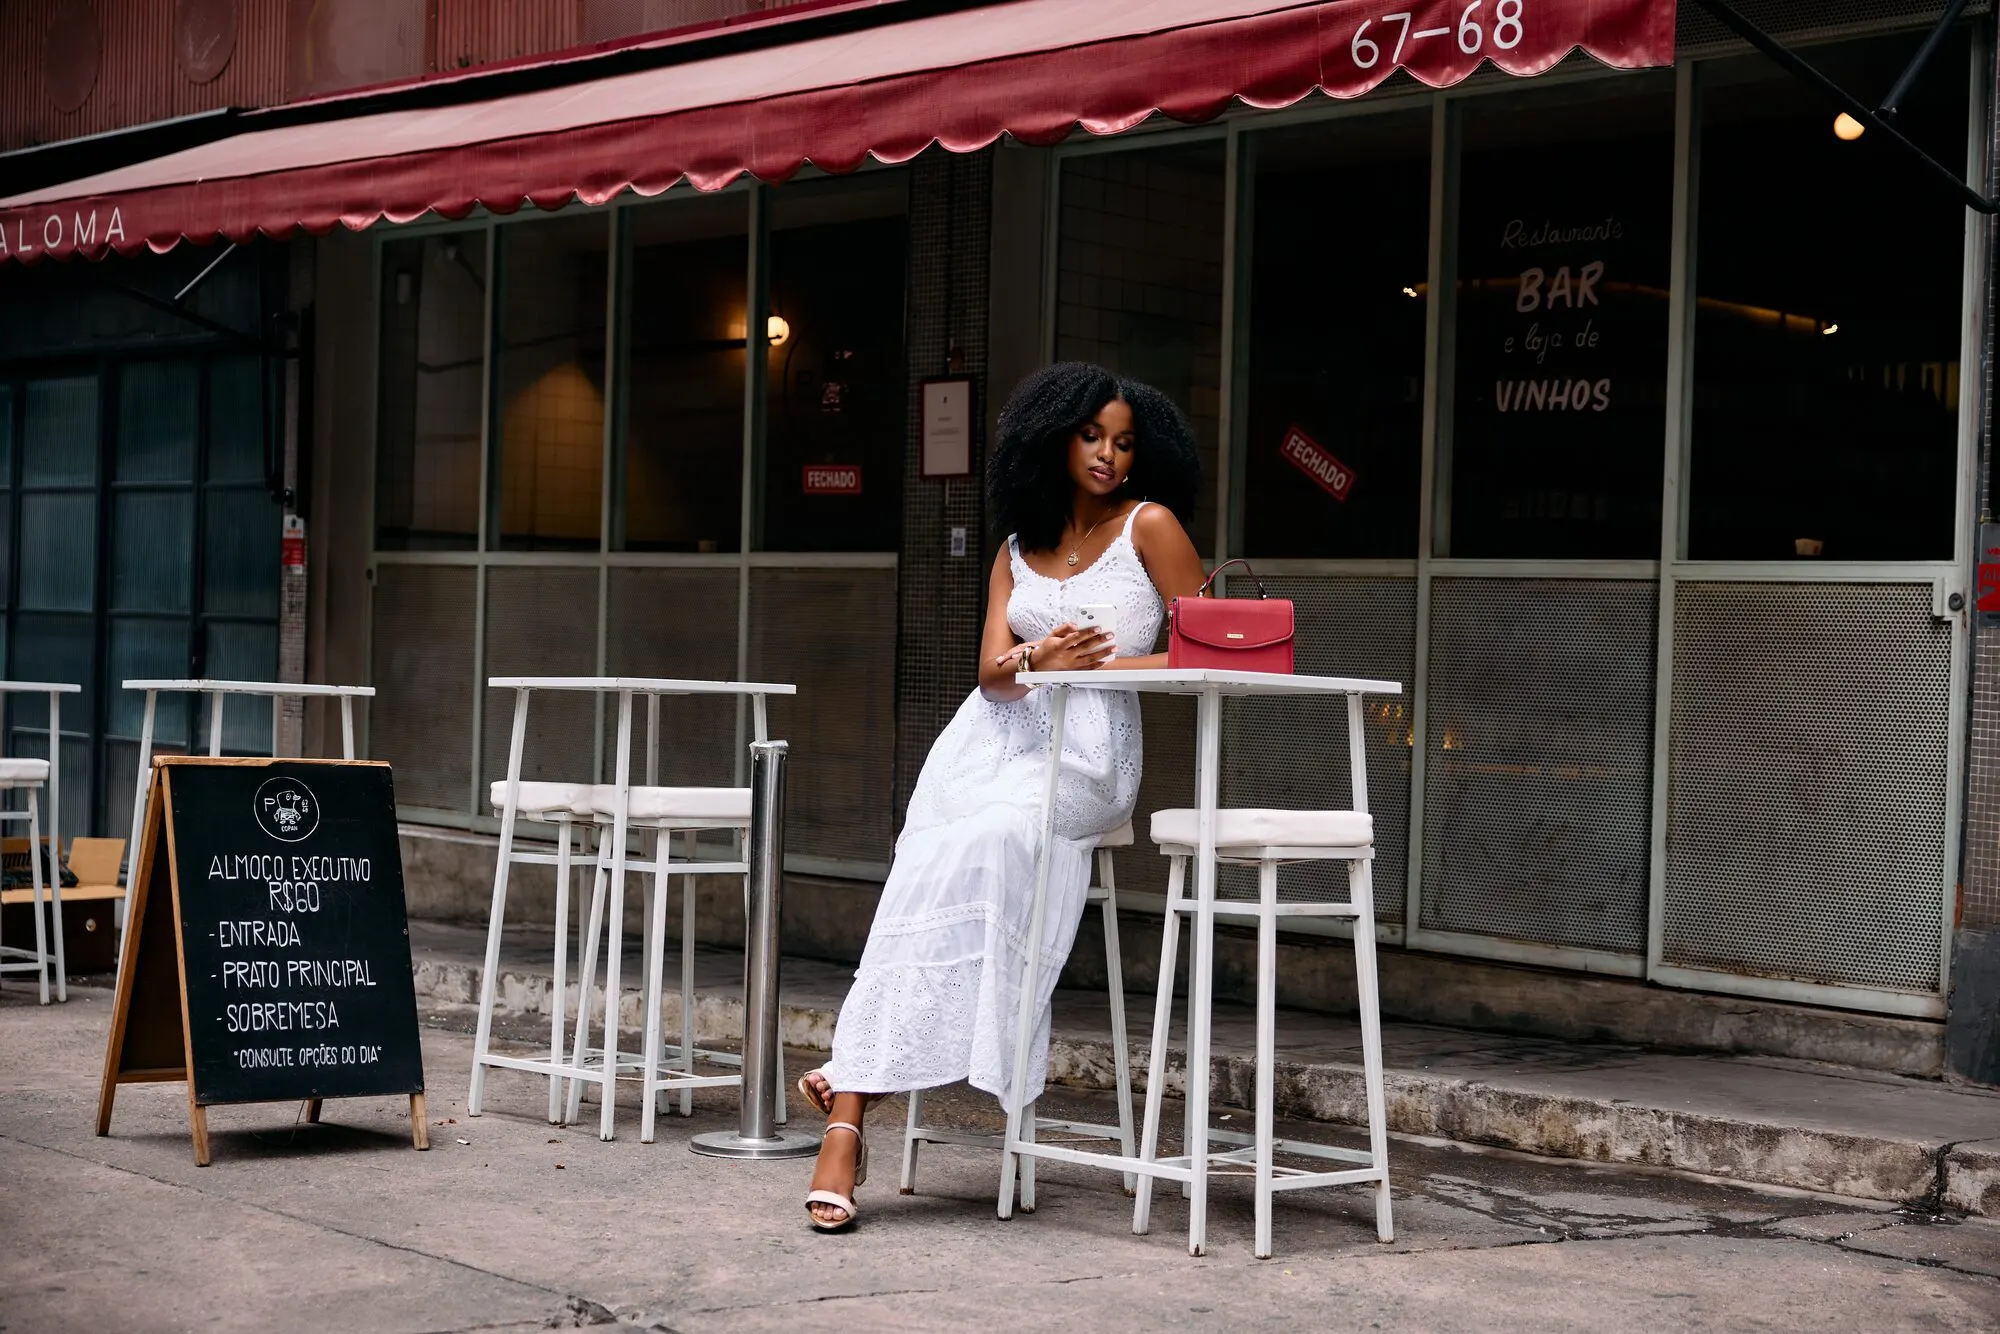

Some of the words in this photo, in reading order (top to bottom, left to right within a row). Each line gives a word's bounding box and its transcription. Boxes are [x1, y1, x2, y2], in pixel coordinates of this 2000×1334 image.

[1501, 212, 1625, 249] Restaurante
[1516, 259, 1605, 313] BAR
[1503, 334, 1515, 354] e
[1524, 320, 1564, 365] loja
[1575, 317, 1600, 349] de
[1495, 377, 1612, 413] VINHOS
[1286, 433, 1347, 491] FECHADO
[807, 470, 857, 489] FECHADO
[263, 797, 276, 812] P
[280, 825, 299, 833] COPAN
[208, 854, 284, 882] ALMOÇO
[292, 855, 371, 882] EXECUTIVO
[269, 879, 320, 914] R$60
[286, 959, 377, 988] PRINCIPAL
[341, 1045, 357, 1065] DO
